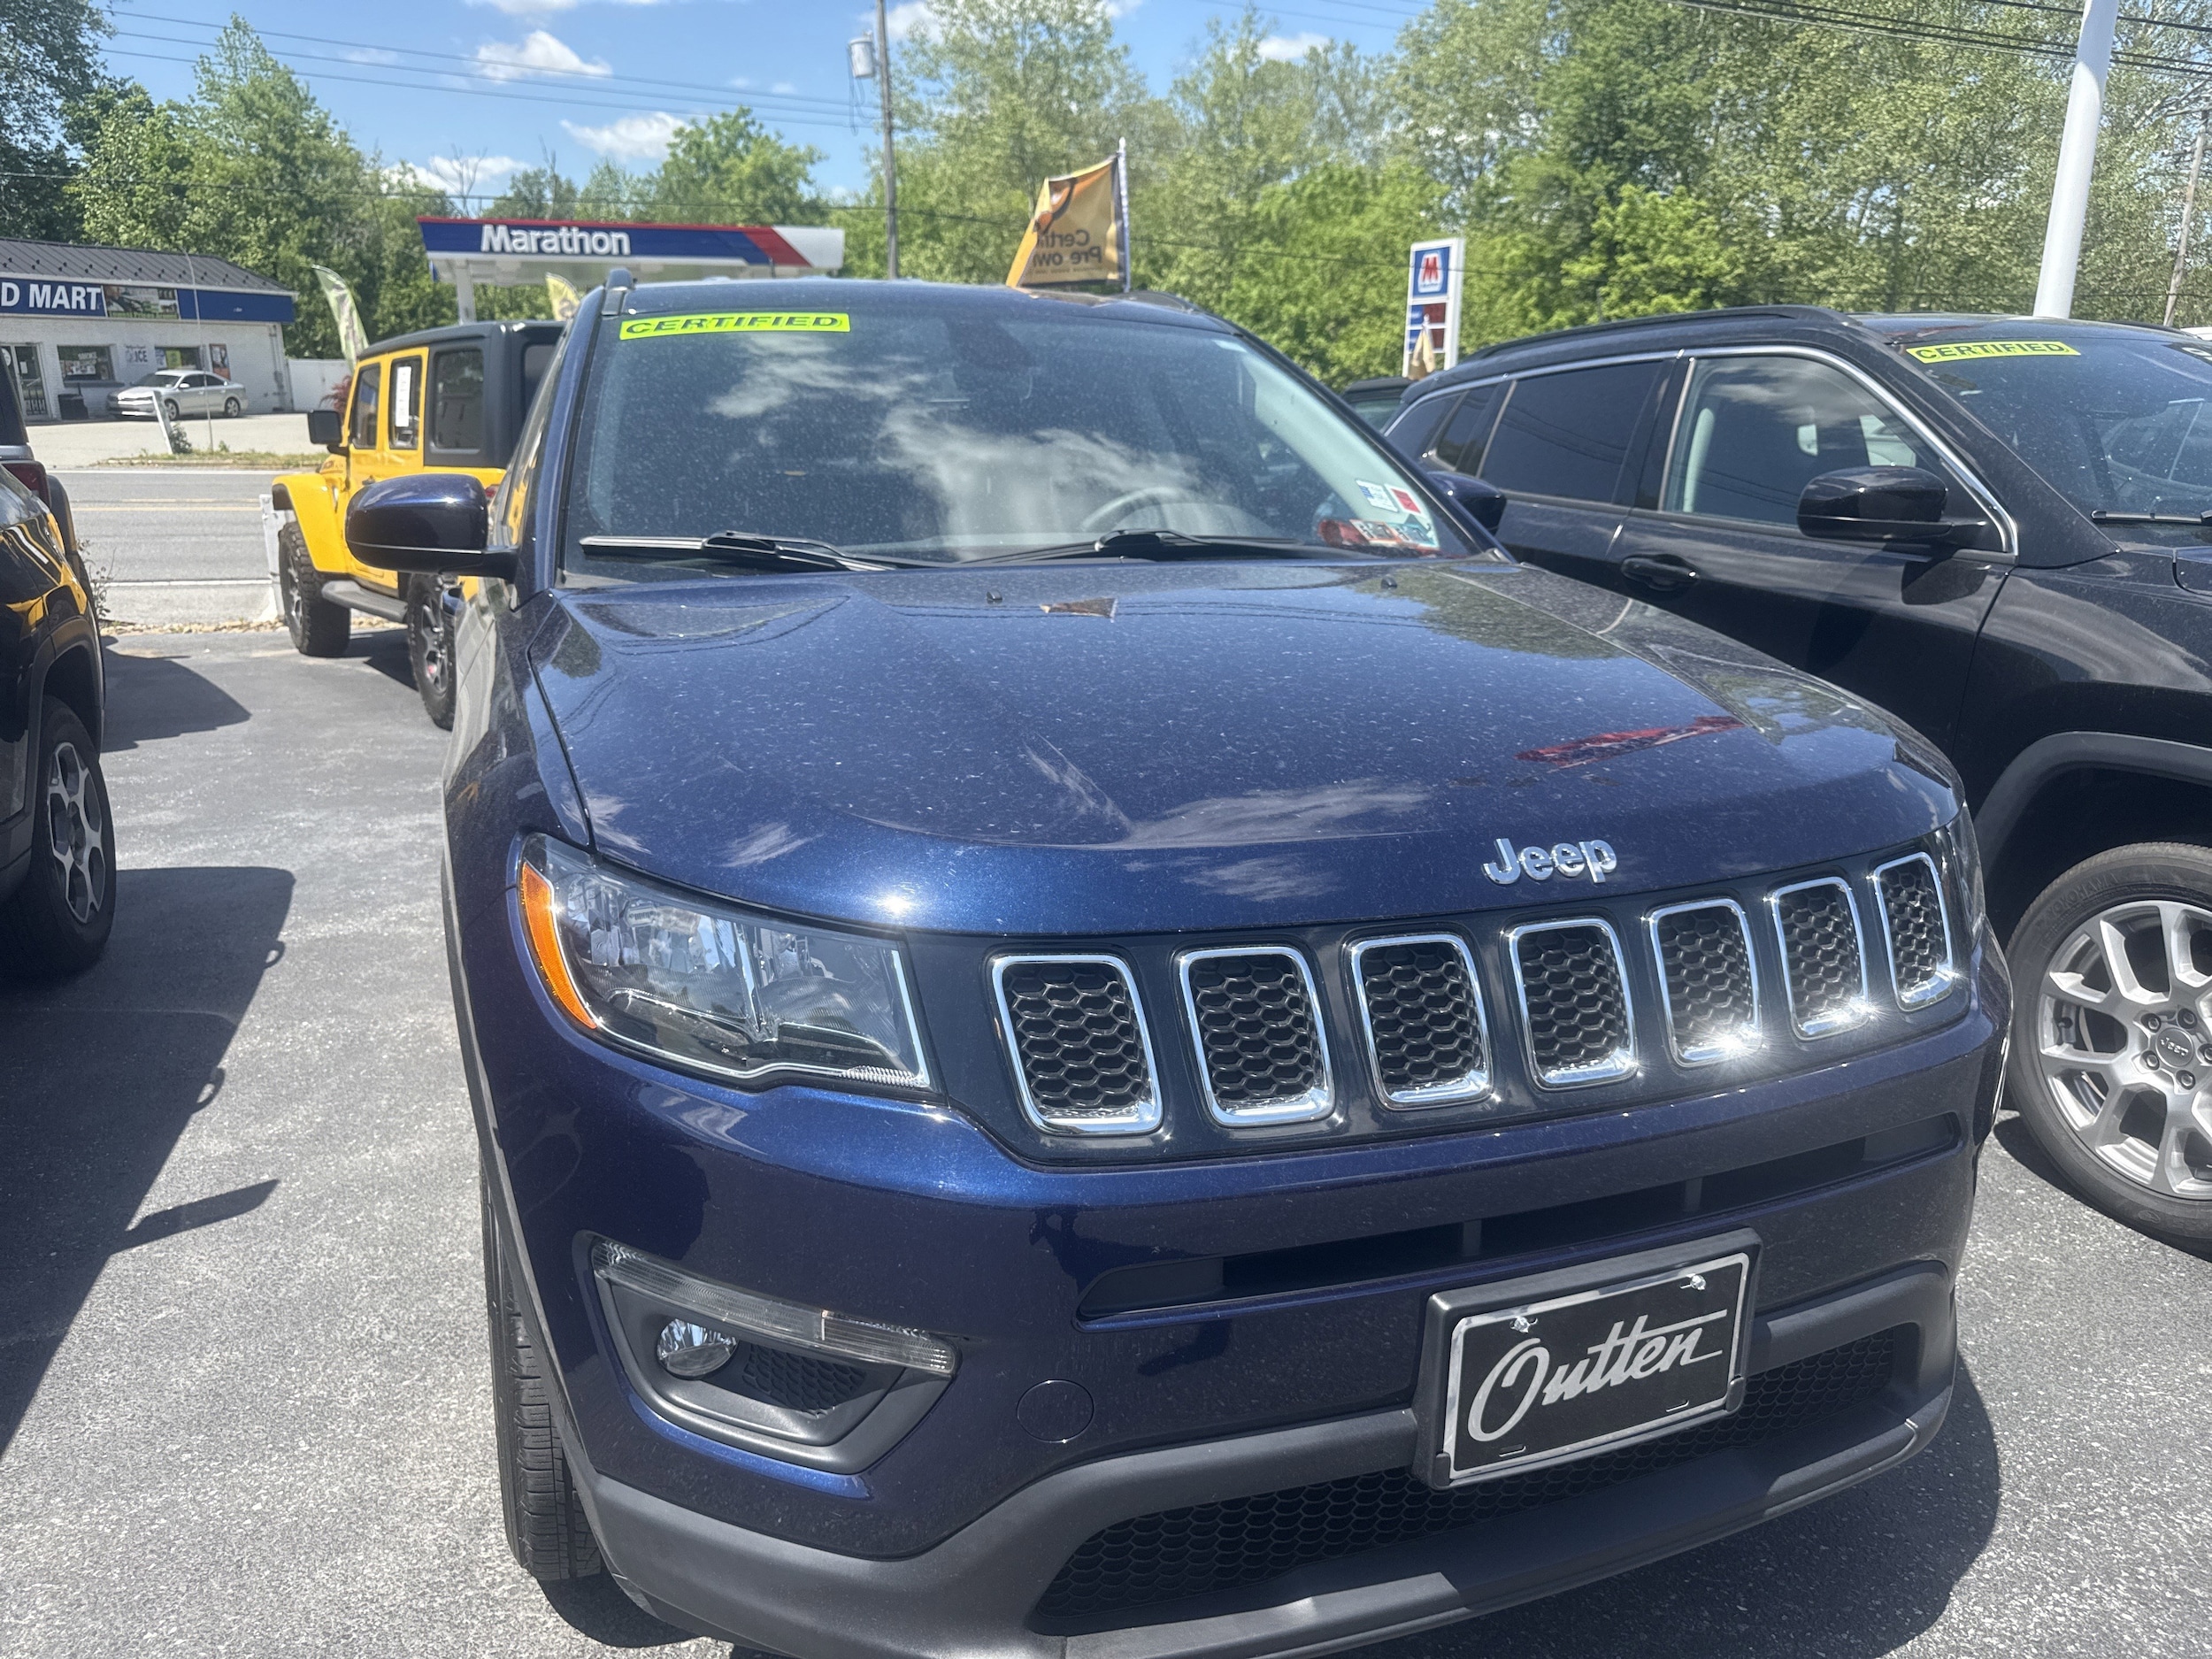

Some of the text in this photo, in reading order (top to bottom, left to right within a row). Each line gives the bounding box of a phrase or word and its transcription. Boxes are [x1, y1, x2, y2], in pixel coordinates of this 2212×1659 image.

[481, 224, 631, 255] Marathon
[29, 283, 101, 311] MART
[626, 316, 841, 334] CERTIFIED
[1915, 342, 2067, 359] CERTIFIED
[1481, 838, 1617, 885] Jeep
[2160, 1037, 2189, 1057] Jeep
[1468, 1310, 1727, 1441] Outten
